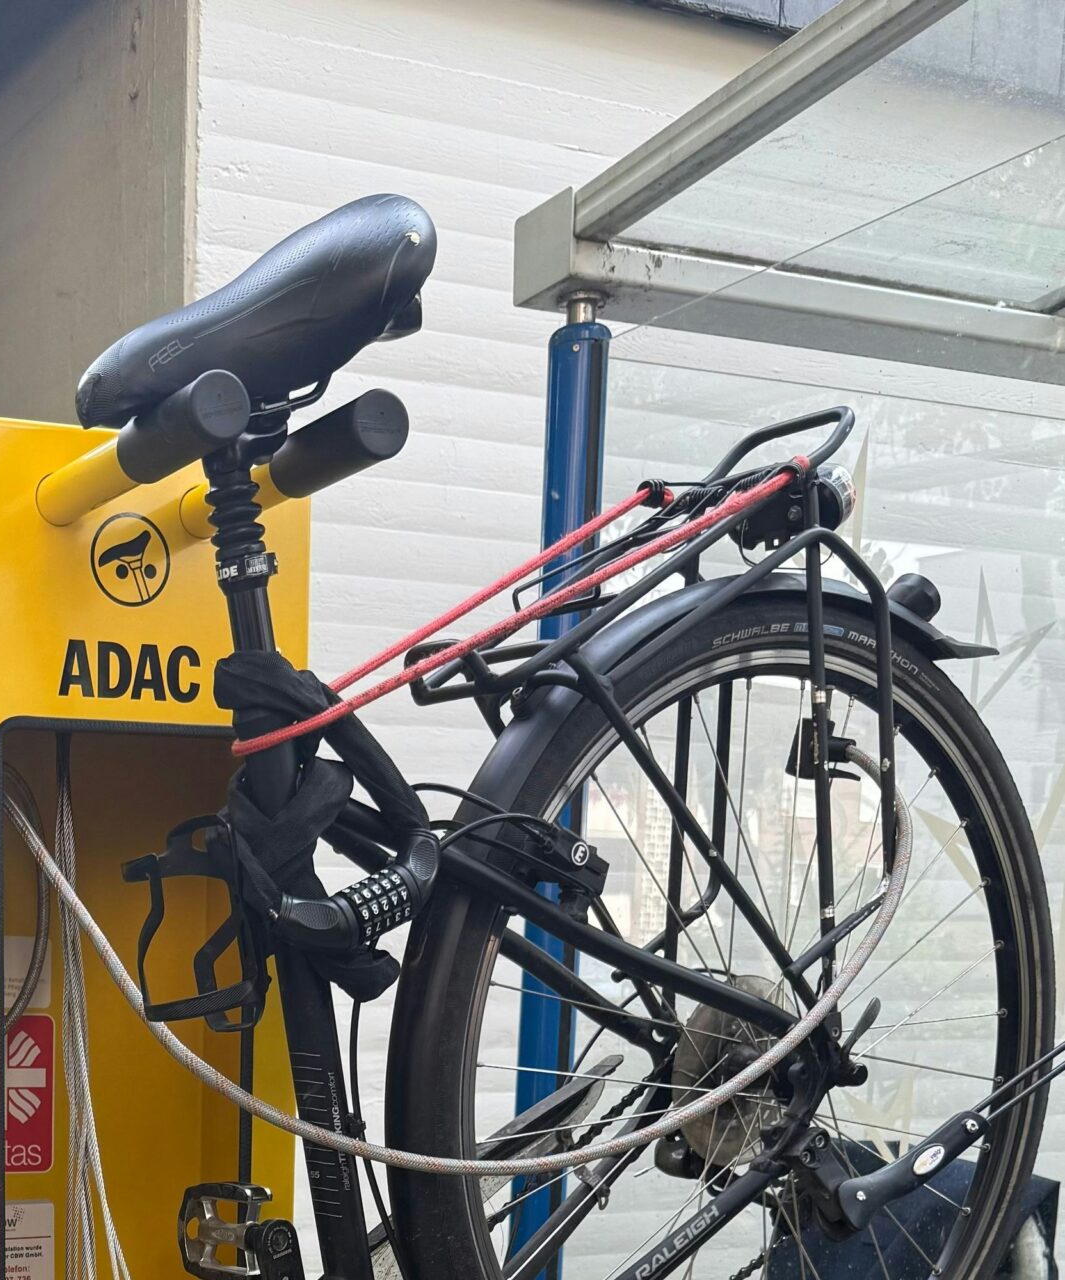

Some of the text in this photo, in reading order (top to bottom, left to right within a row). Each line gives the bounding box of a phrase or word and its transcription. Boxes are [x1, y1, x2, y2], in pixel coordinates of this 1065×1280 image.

[147, 339, 194, 373] FEEL
[711, 622, 791, 650] SCHWALBE
[58, 639, 201, 703] ADAC
